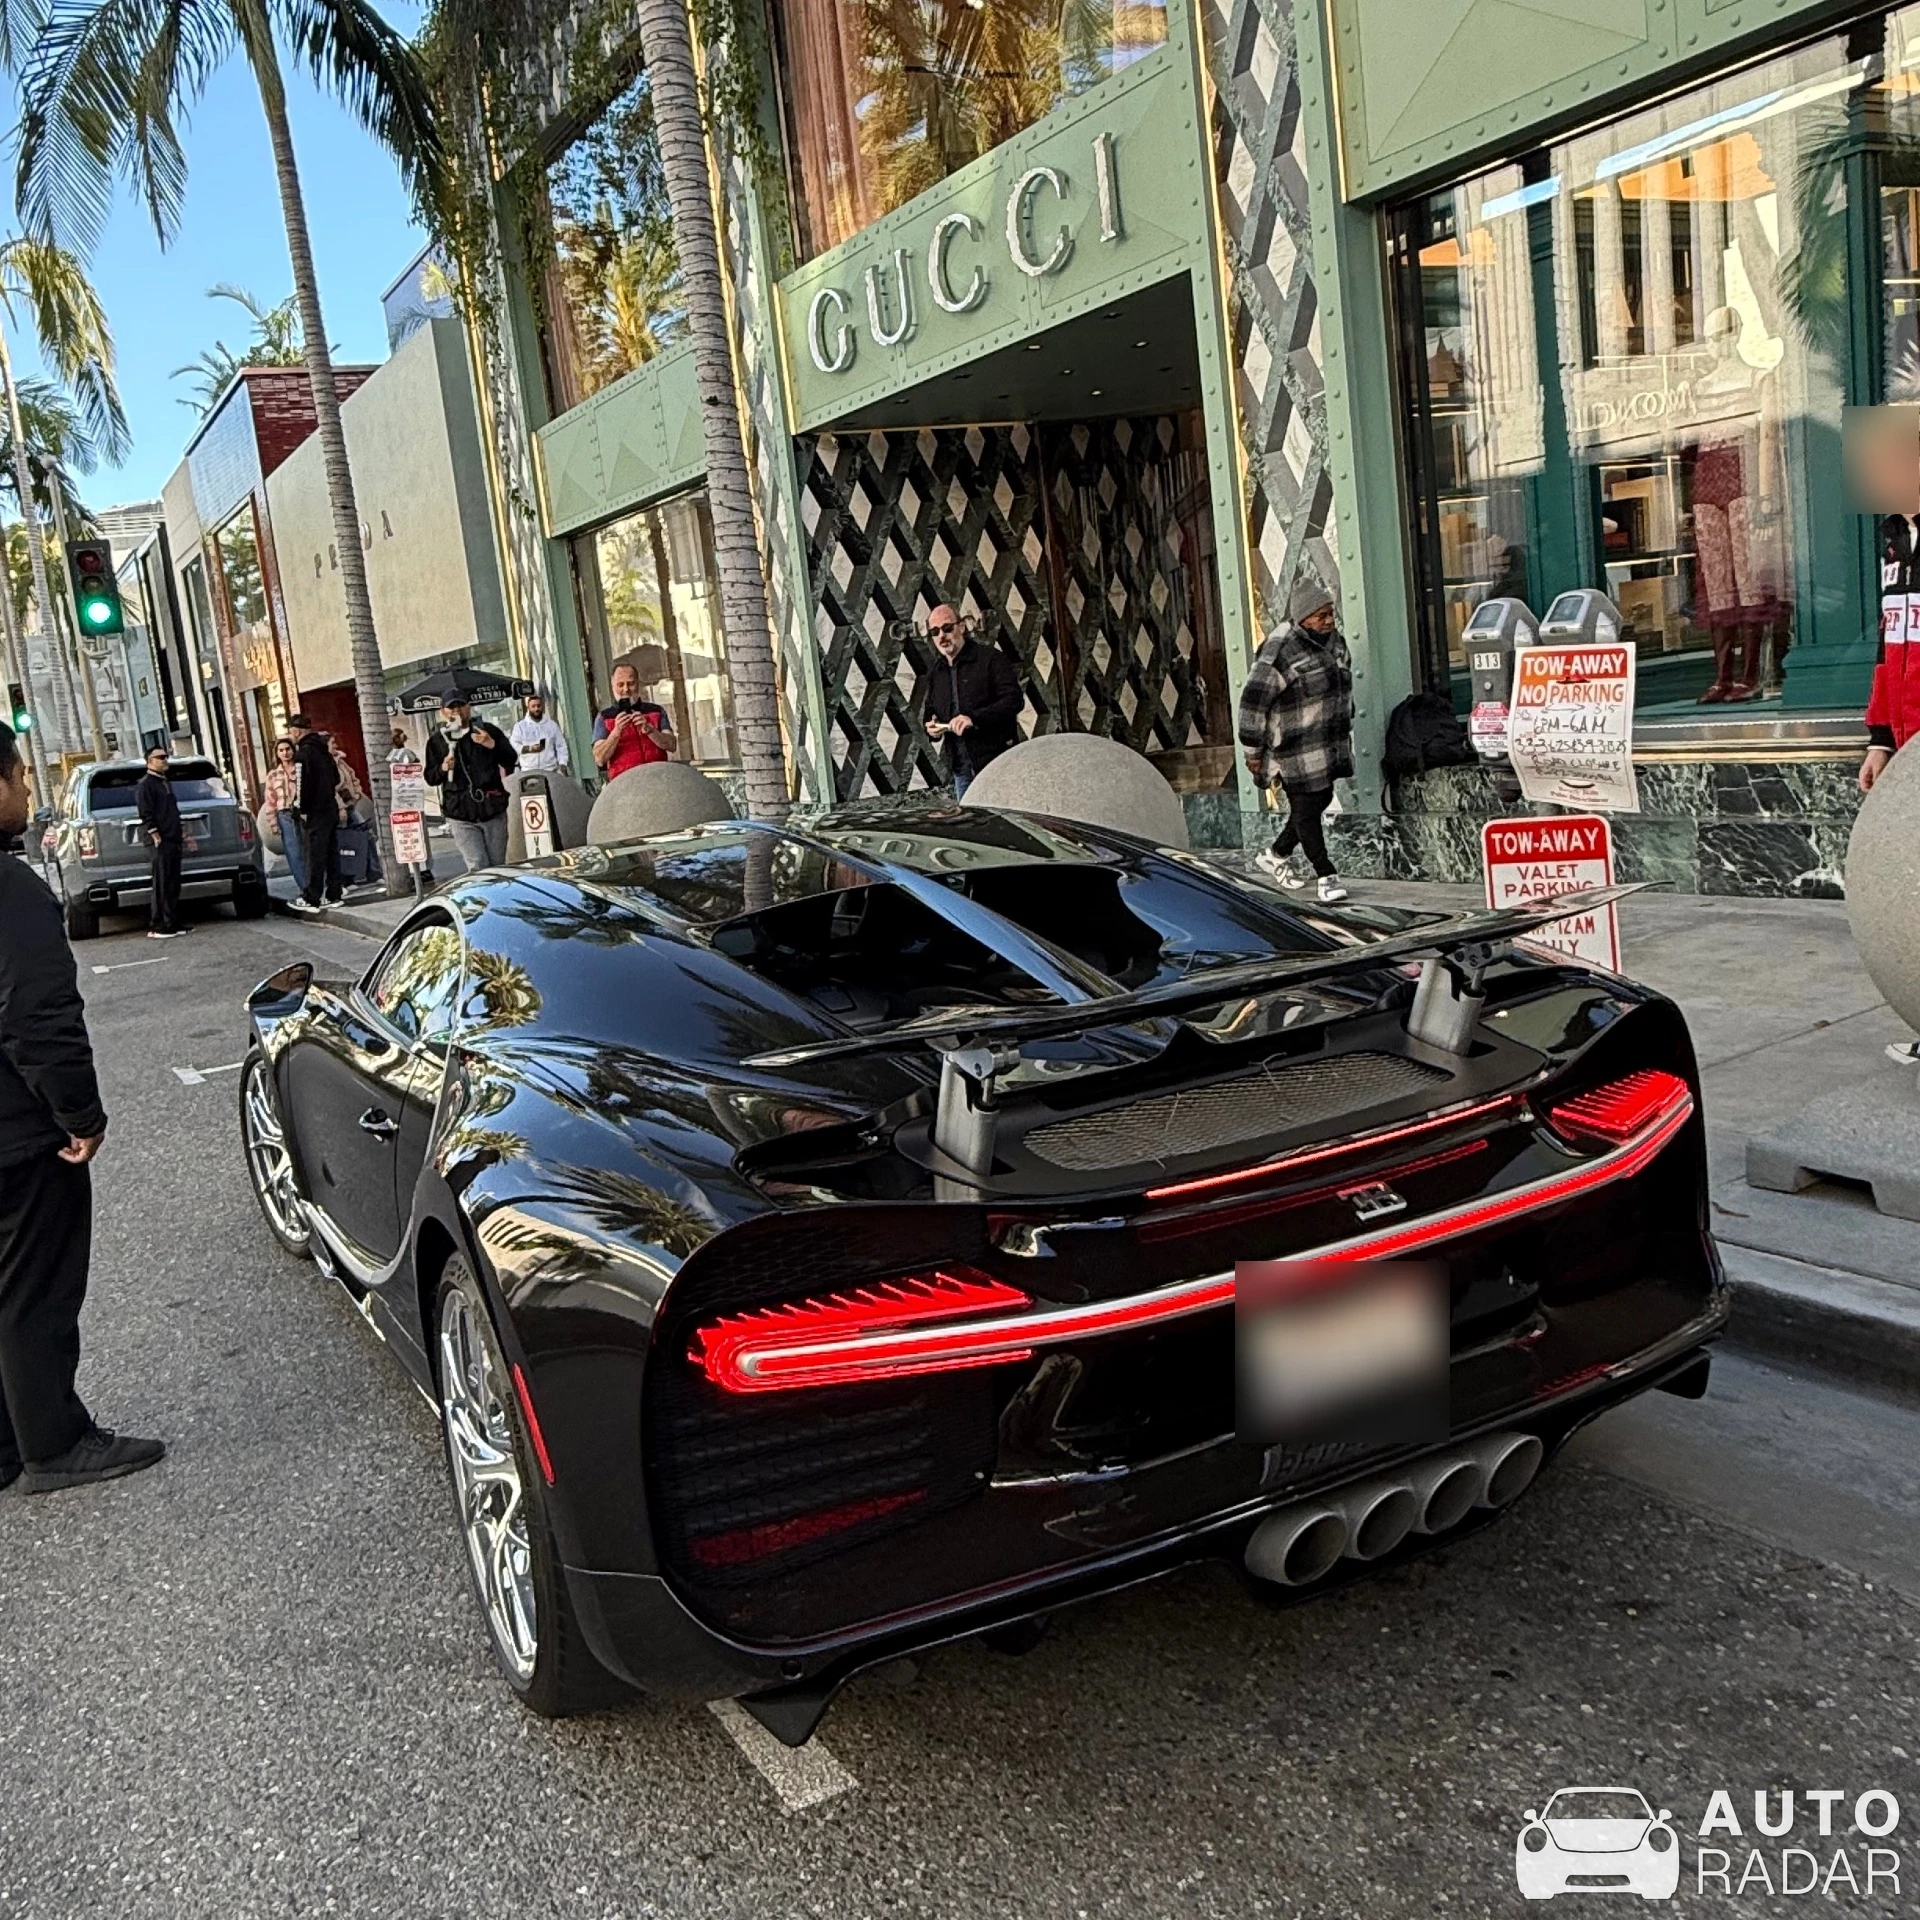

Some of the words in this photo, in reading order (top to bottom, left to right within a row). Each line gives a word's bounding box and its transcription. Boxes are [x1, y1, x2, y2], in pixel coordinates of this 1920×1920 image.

[808, 132, 1118, 373] GUCCI
[314, 510, 393, 578] PRDA
[1476, 653, 1499, 668] 313
[1523, 653, 1625, 676] TOW-AWAY
[1518, 684, 1546, 704] NO
[1550, 683, 1625, 703] PARKING
[1491, 827, 1600, 855] TOW-AWAY
[1517, 864, 1579, 880] VALET
